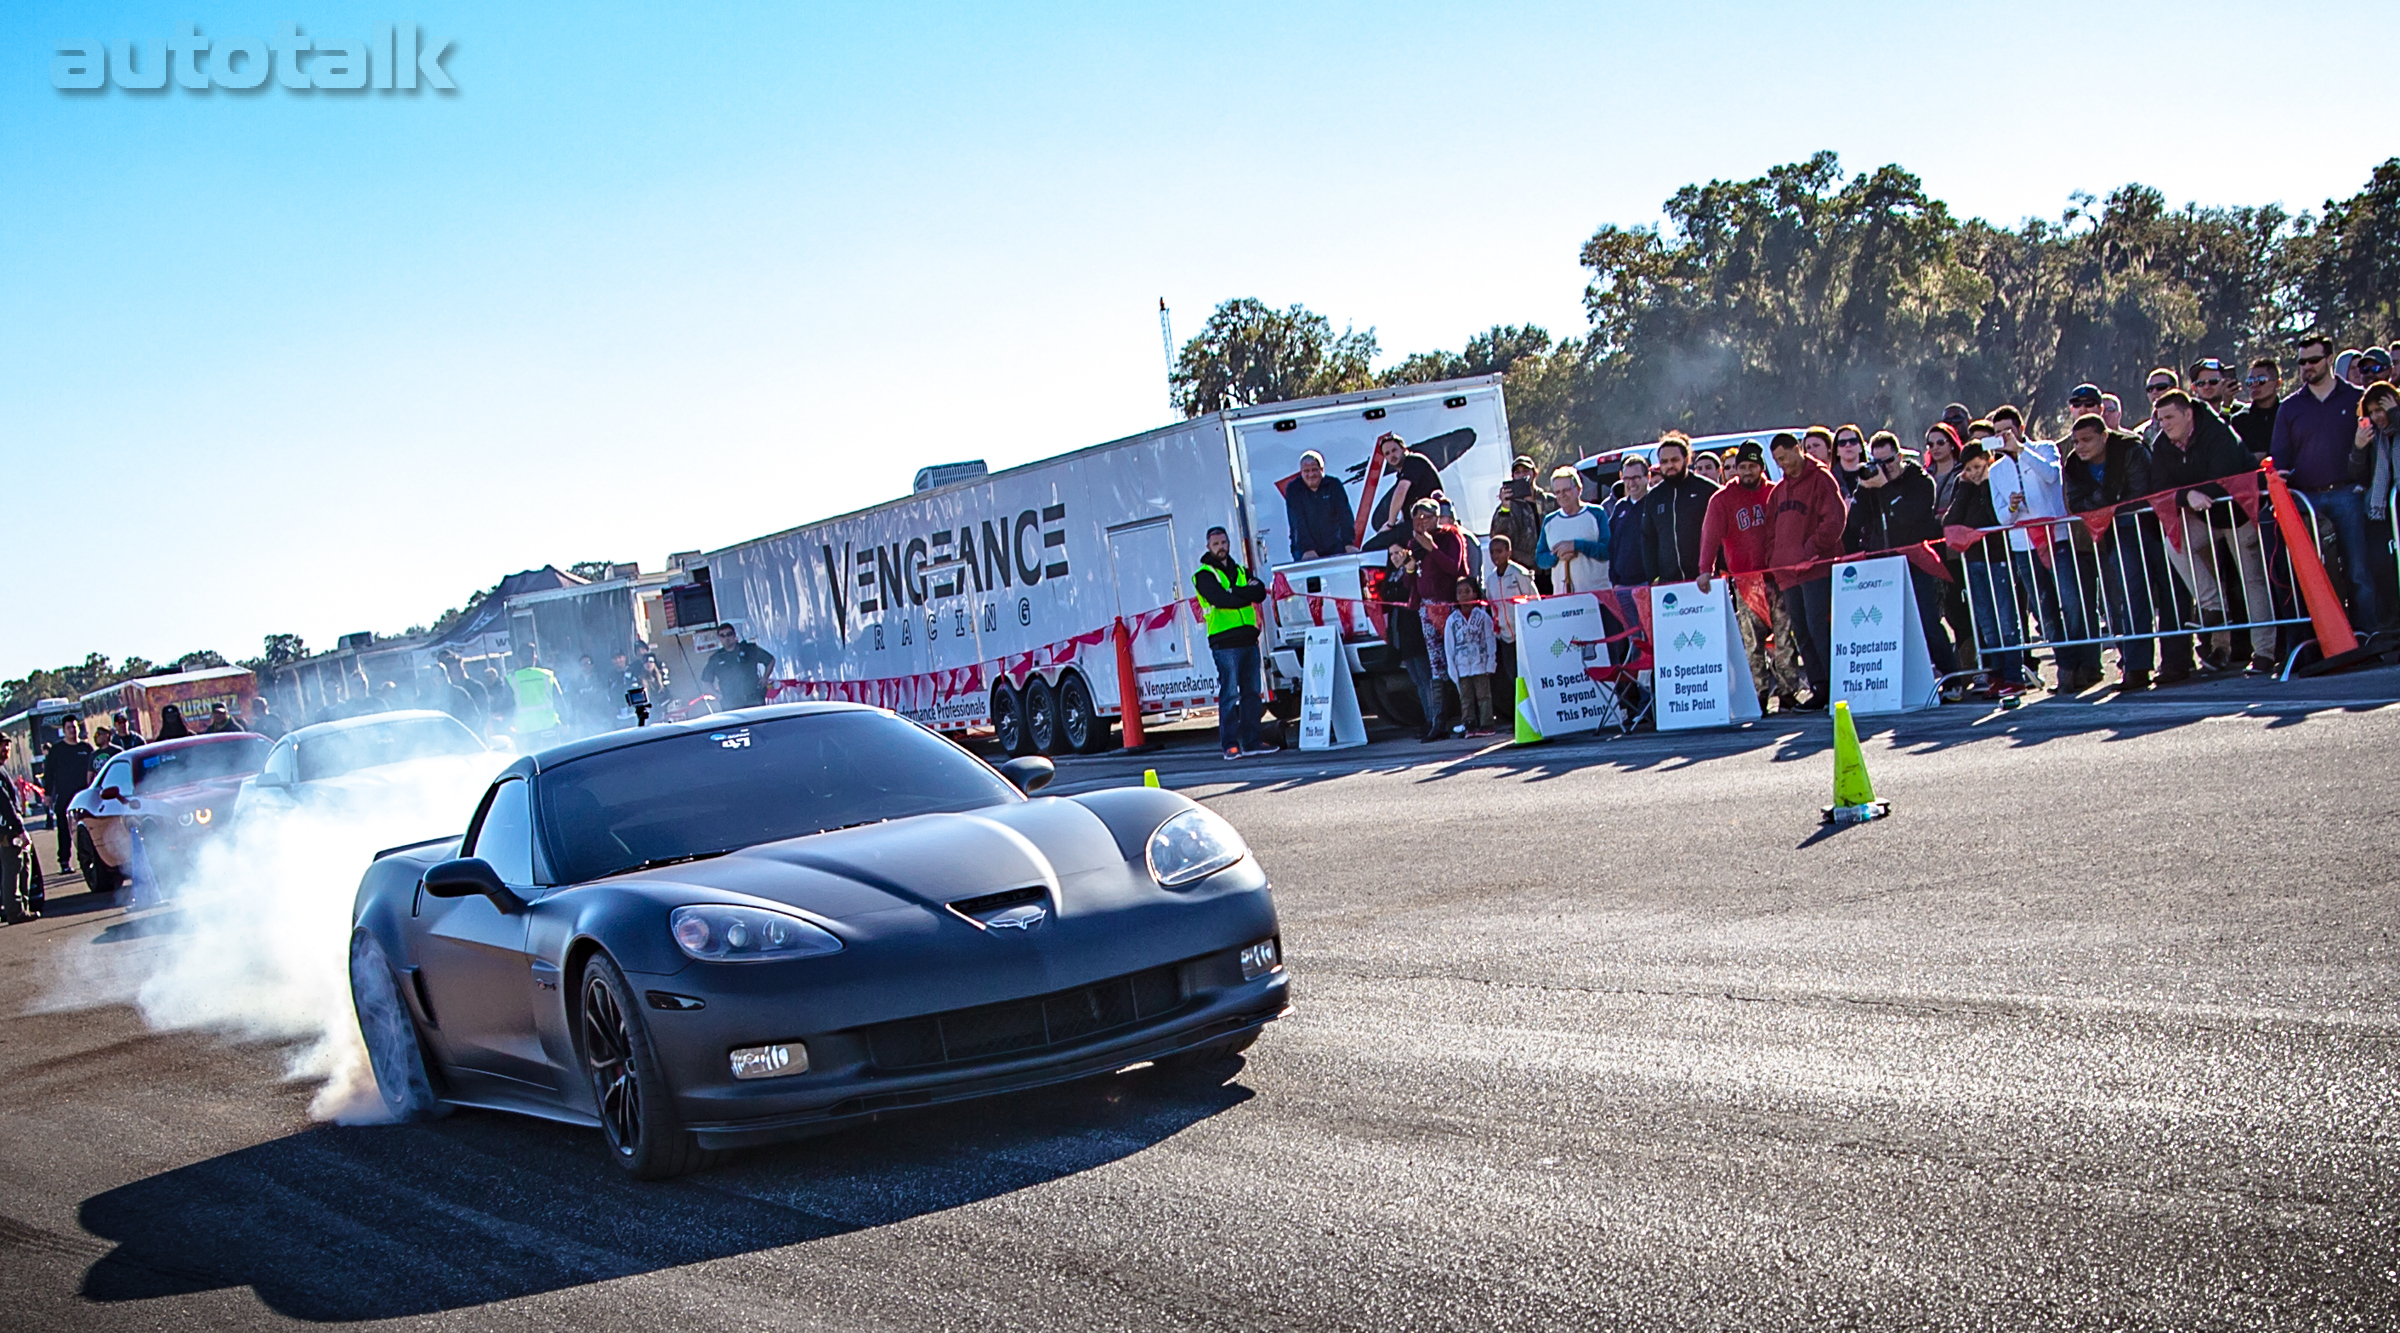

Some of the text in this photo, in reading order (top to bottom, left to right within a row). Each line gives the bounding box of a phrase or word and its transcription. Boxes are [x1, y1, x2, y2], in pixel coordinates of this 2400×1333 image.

[823, 503, 1069, 650] VENGEANCE
[874, 597, 1031, 651] RACING
[1836, 640, 1898, 658] No Spectators
[1660, 663, 1723, 680] No Spectators
[1849, 658, 1883, 676] Beyond
[1136, 673, 1220, 700] w.VengeanceRacing.
[1541, 671, 1591, 690] No Specta
[1674, 680, 1709, 697] Beyond
[1843, 677, 1889, 693] This Point
[1559, 687, 1597, 705] Beyond
[936, 697, 986, 720] Professionals
[1556, 706, 1580, 723] This
[1668, 698, 1716, 714] This Point
